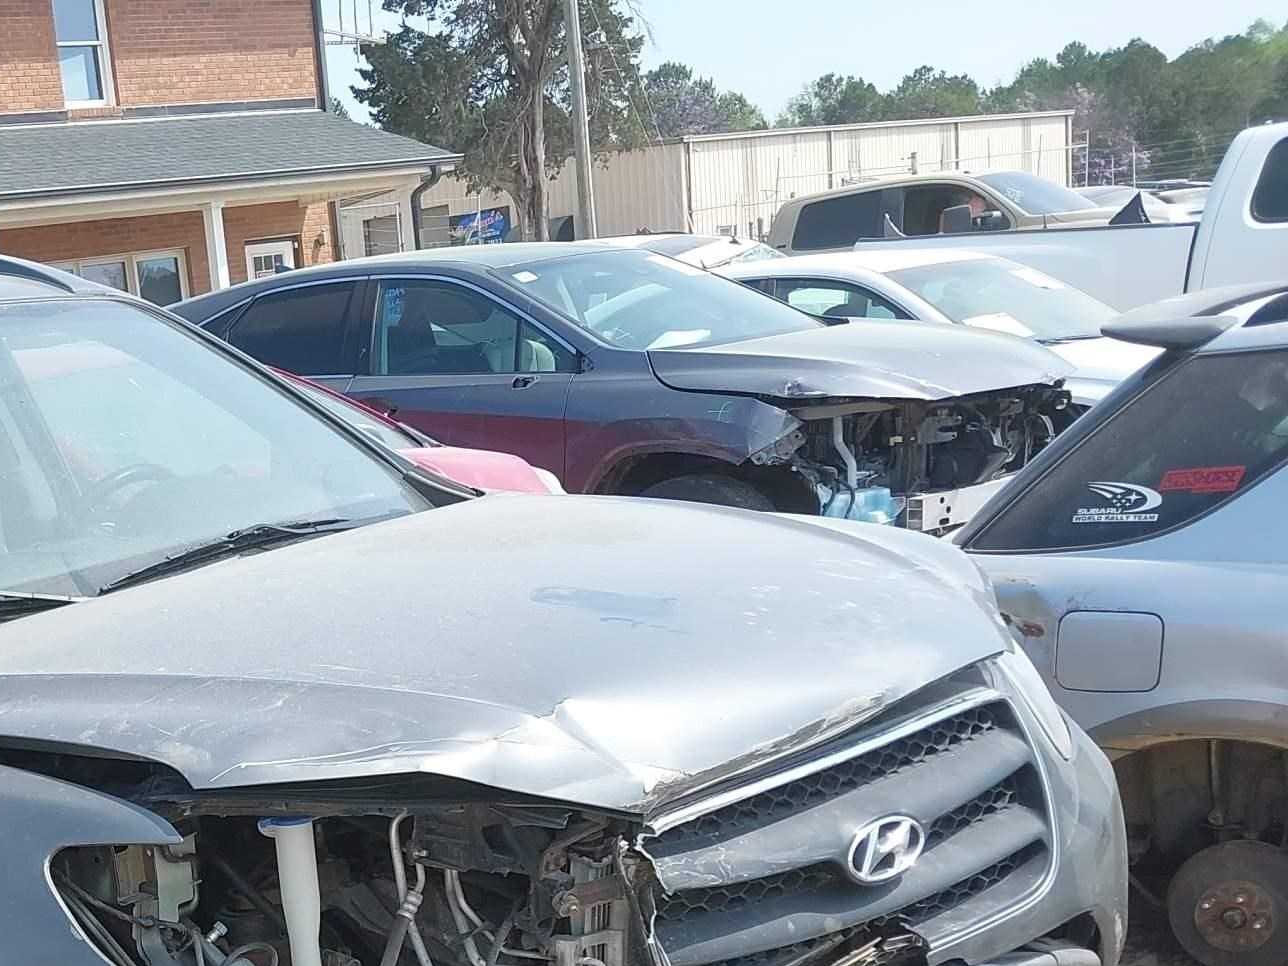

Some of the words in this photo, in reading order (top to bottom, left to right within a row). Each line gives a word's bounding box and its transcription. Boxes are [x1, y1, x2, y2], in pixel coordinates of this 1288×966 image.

[1077, 507, 1122, 515] SUBARU
[1073, 514, 1103, 522] WORLD
[1132, 514, 1157, 522] TEAM
